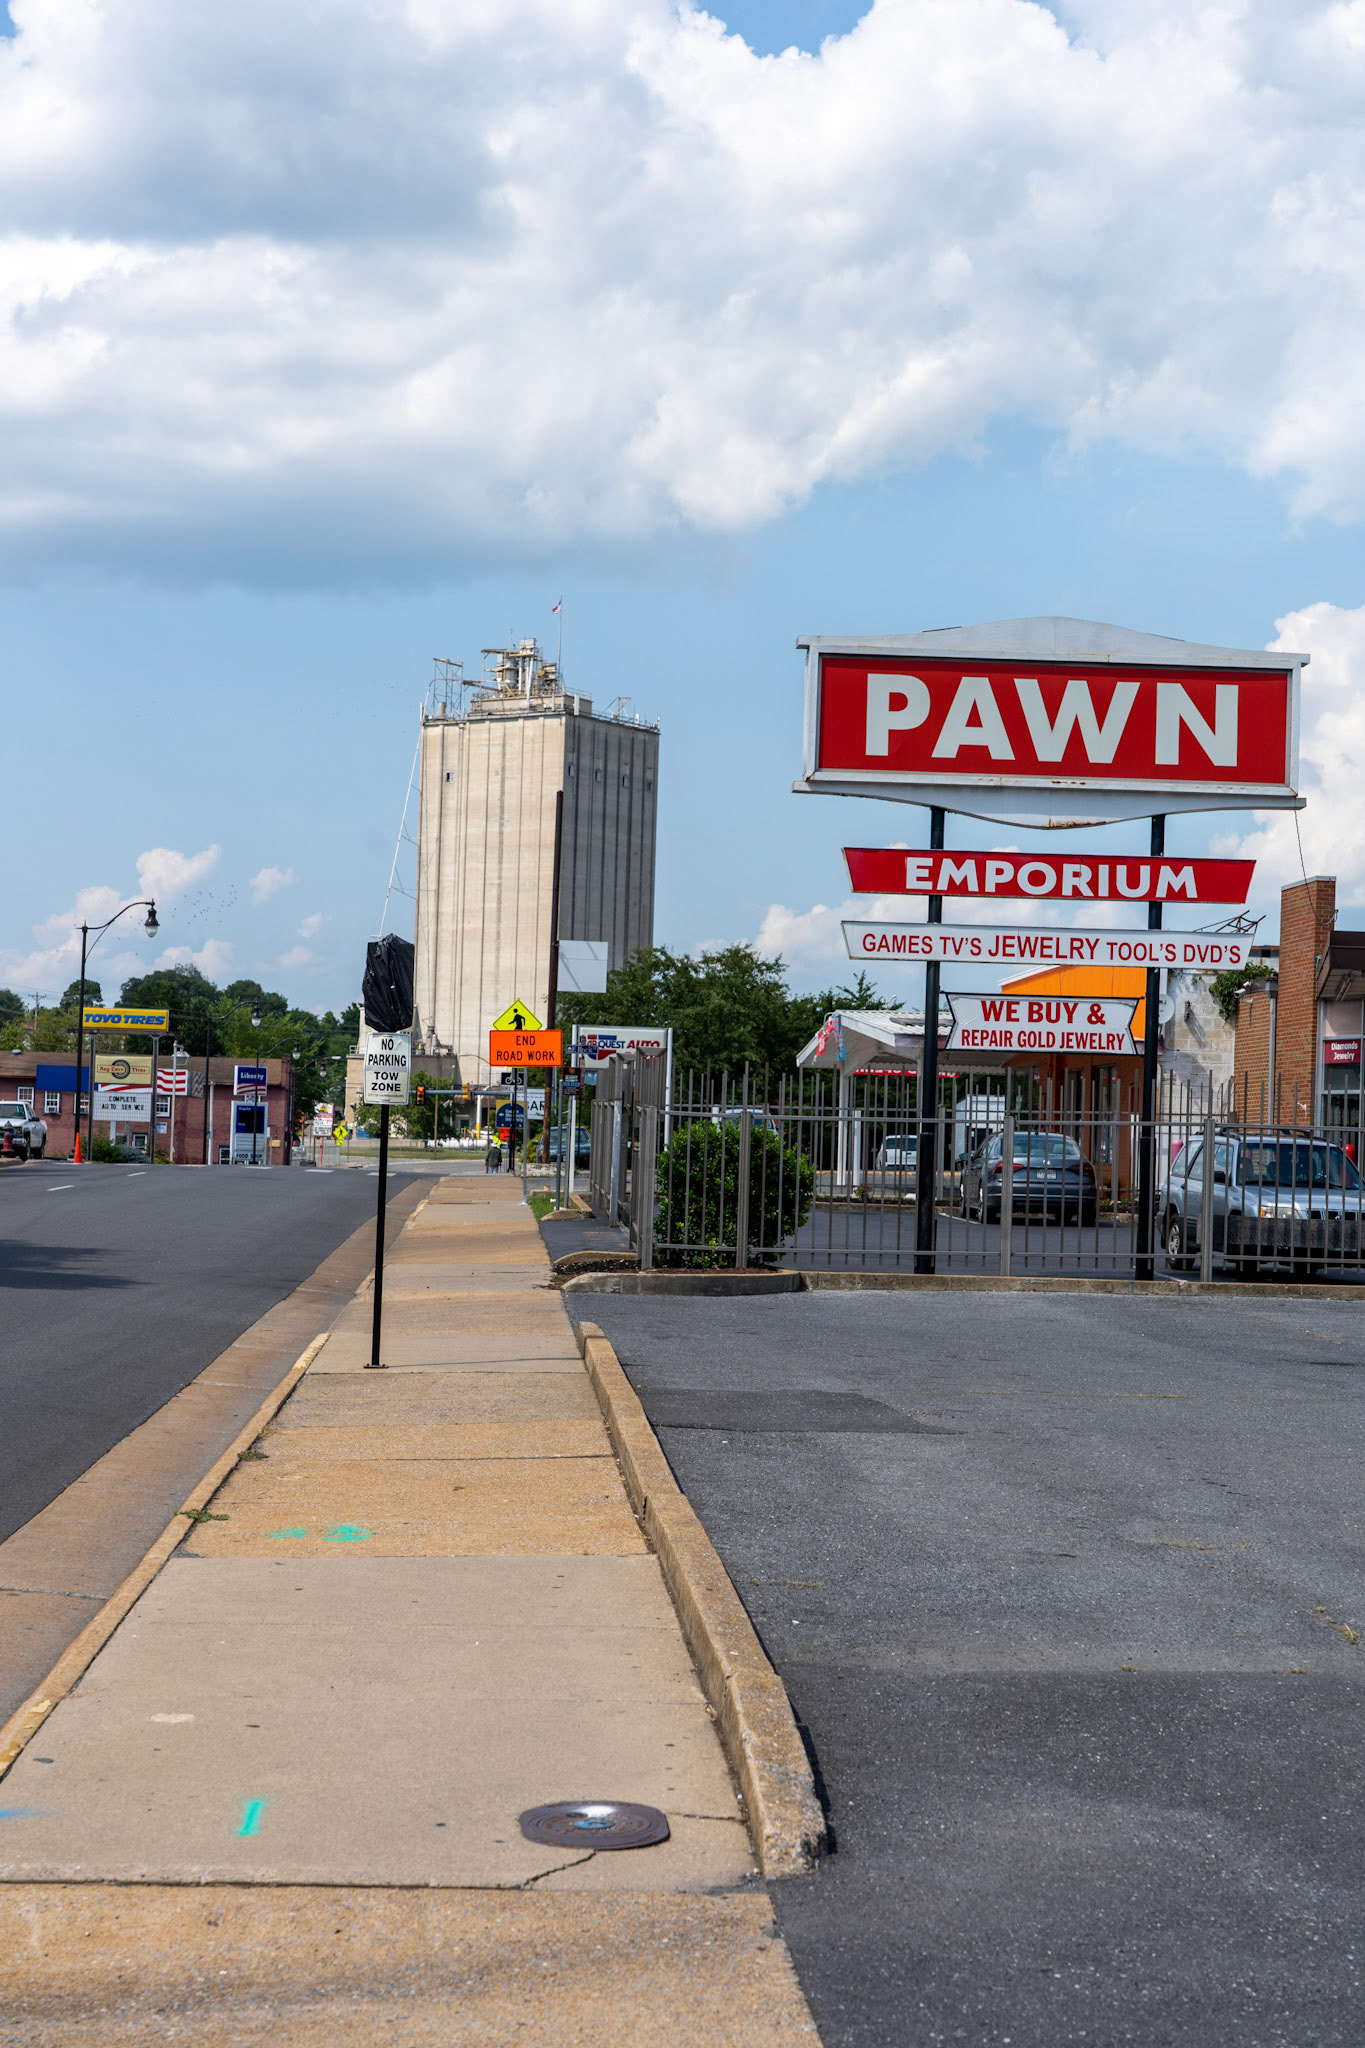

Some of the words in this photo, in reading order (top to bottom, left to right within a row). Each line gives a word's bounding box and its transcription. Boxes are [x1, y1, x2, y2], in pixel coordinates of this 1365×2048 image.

[865, 673, 1239, 768] PAWN
[904, 857, 1198, 899] EMPORIUM
[862, 933, 933, 955] GAMES
[939, 936, 982, 956] TV'S
[988, 935, 1099, 961] JEWELRY
[1106, 941, 1177, 963] TOOL'S
[1182, 943, 1241, 964] DVD'S
[981, 1000, 1019, 1022] WE
[1027, 1002, 1081, 1024] BUY
[1086, 1003, 1106, 1025] &
[84, 1014, 122, 1024] TOYO
[123, 1015, 166, 1025] TIRES
[381, 1038, 394, 1050] NO
[516, 1036, 536, 1046] END
[961, 1029, 1013, 1047] REPAIR
[1016, 1030, 1056, 1048] GOLD
[1058, 1031, 1125, 1050] JEWELRY
[1331, 1042, 1359, 1051] Diamonds
[368, 1054, 407, 1067] PARKING
[496, 1051, 523, 1061] ROAD
[527, 1051, 555, 1061] WORK
[1333, 1052, 1355, 1061] Jewelry
[374, 1071, 399, 1081] TOW
[371, 1082, 401, 1092] ZONE
